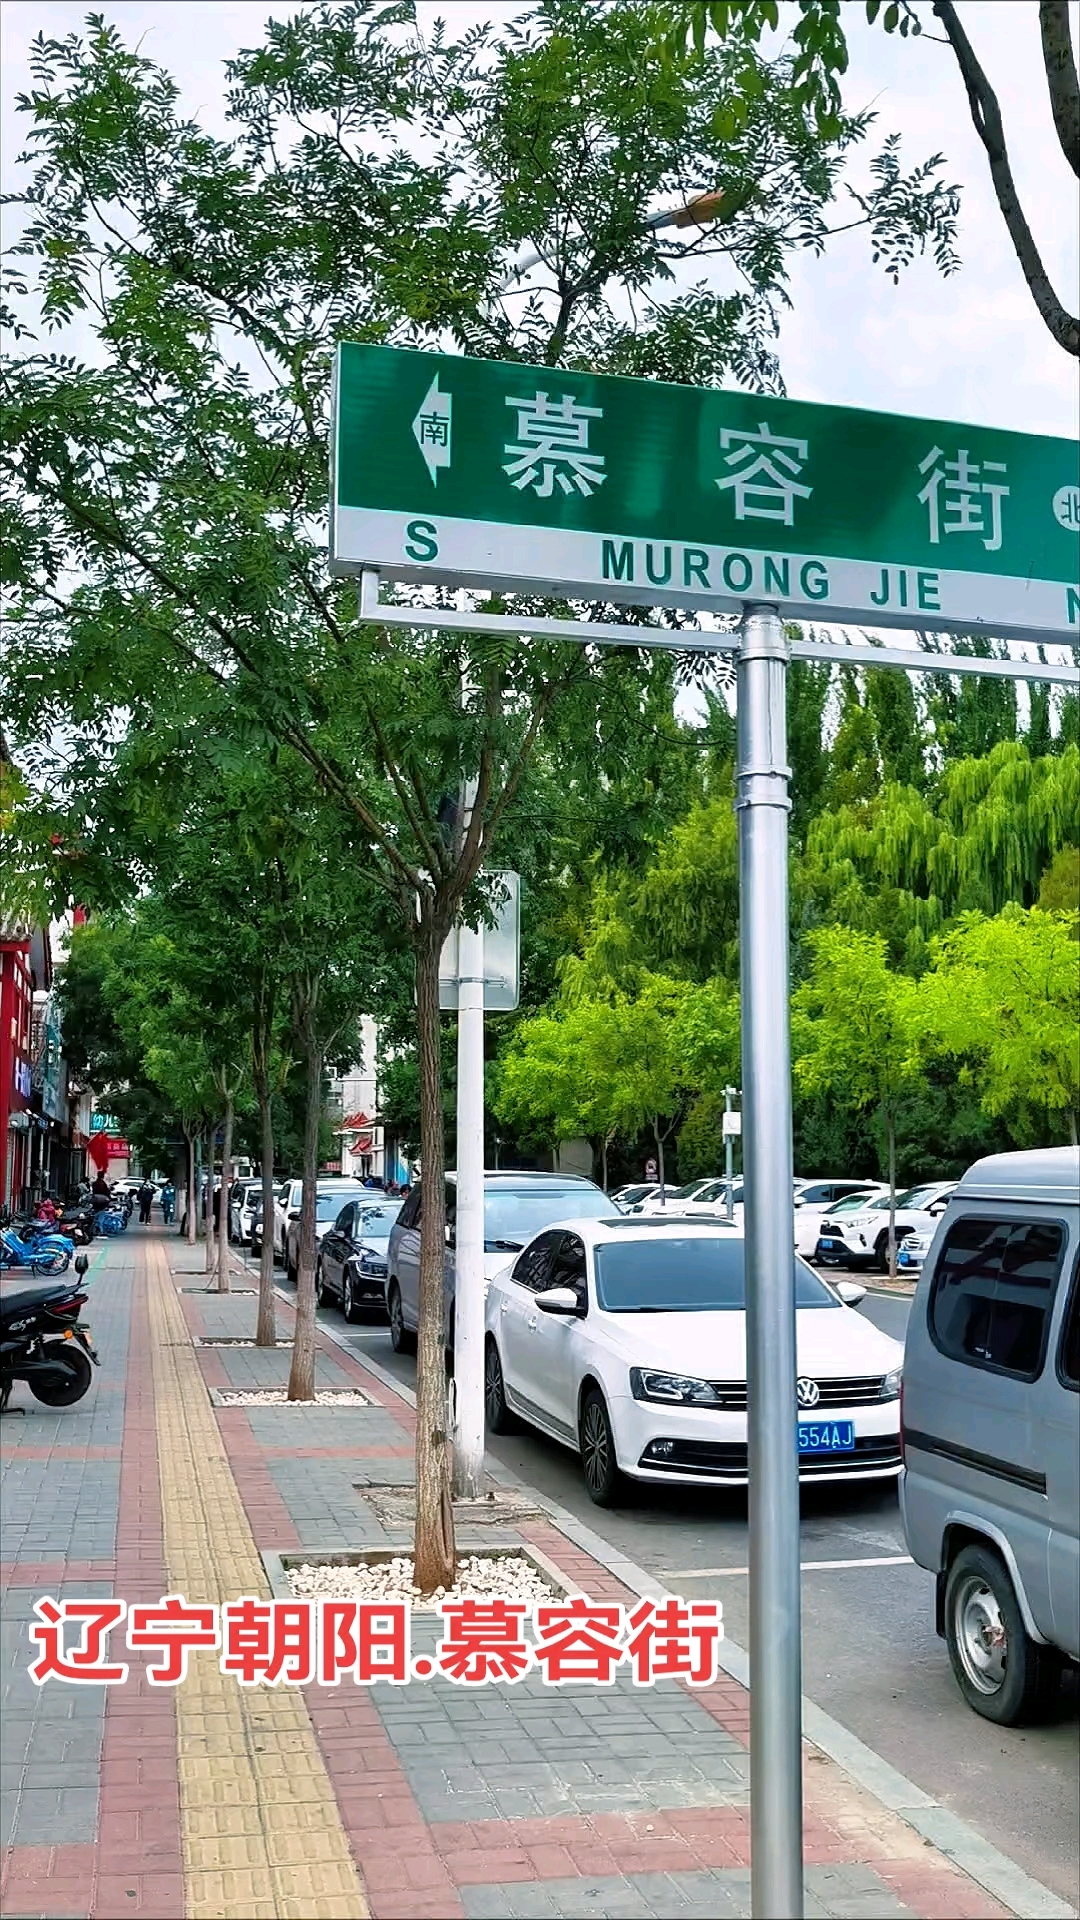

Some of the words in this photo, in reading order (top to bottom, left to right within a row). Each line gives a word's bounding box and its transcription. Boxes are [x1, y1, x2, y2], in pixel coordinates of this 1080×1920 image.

[420, 412, 449, 446] 南
[501, 391, 1010, 550] 慕容街
[405, 520, 438, 561] S
[602, 539, 829, 600] MURONG
[870, 569, 941, 611] JIE
